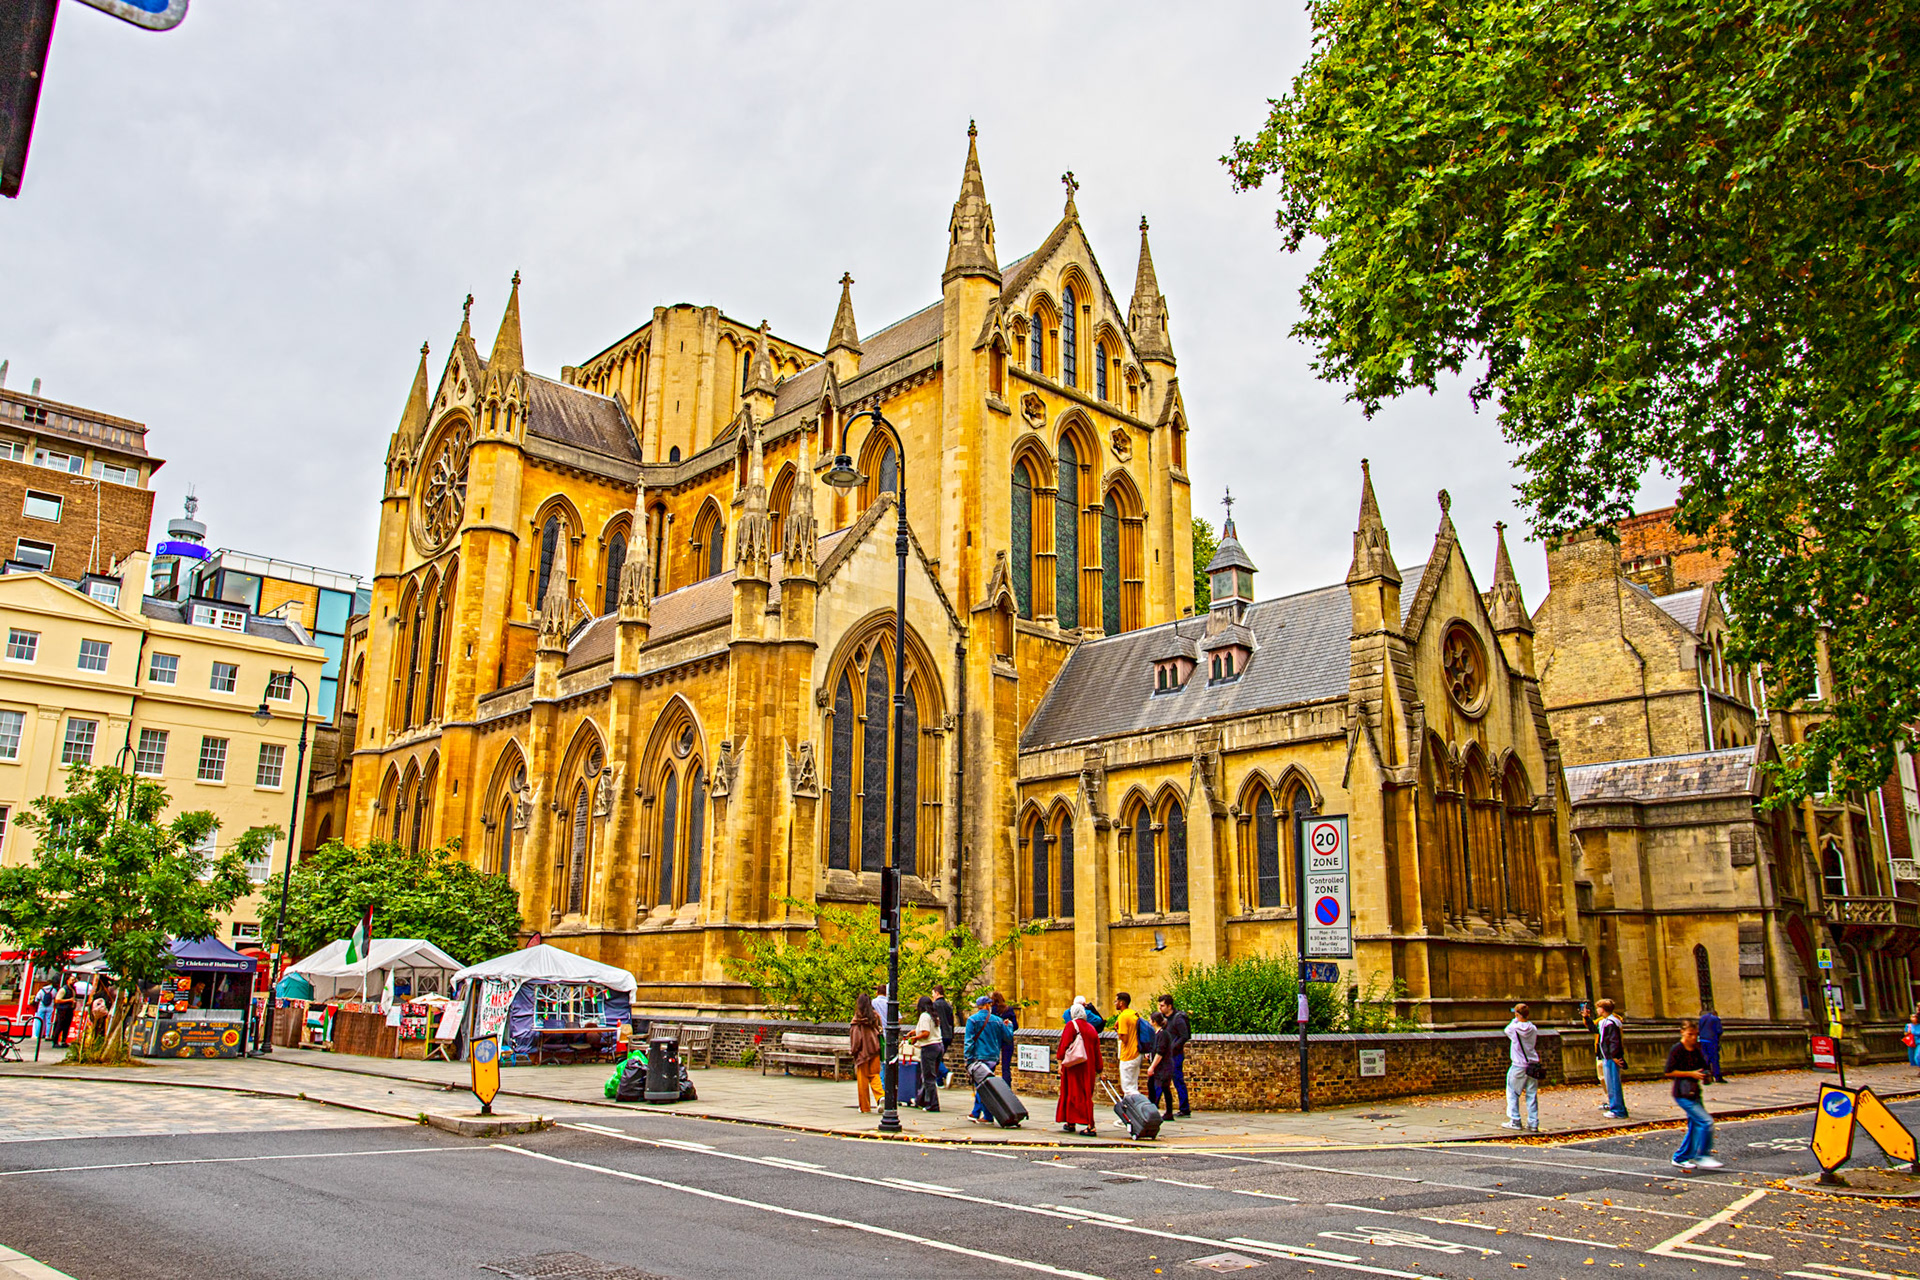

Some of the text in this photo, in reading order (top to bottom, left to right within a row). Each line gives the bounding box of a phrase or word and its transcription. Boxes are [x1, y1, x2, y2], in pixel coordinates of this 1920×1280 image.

[1316, 832, 1335, 847] 20
[1313, 857, 1339, 867] ZONE
[1309, 876, 1344, 885] Controlled
[1314, 885, 1339, 894] ZONE
[1020, 1052, 1032, 1060] BYNG
[1020, 1060, 1034, 1069] PLACE
